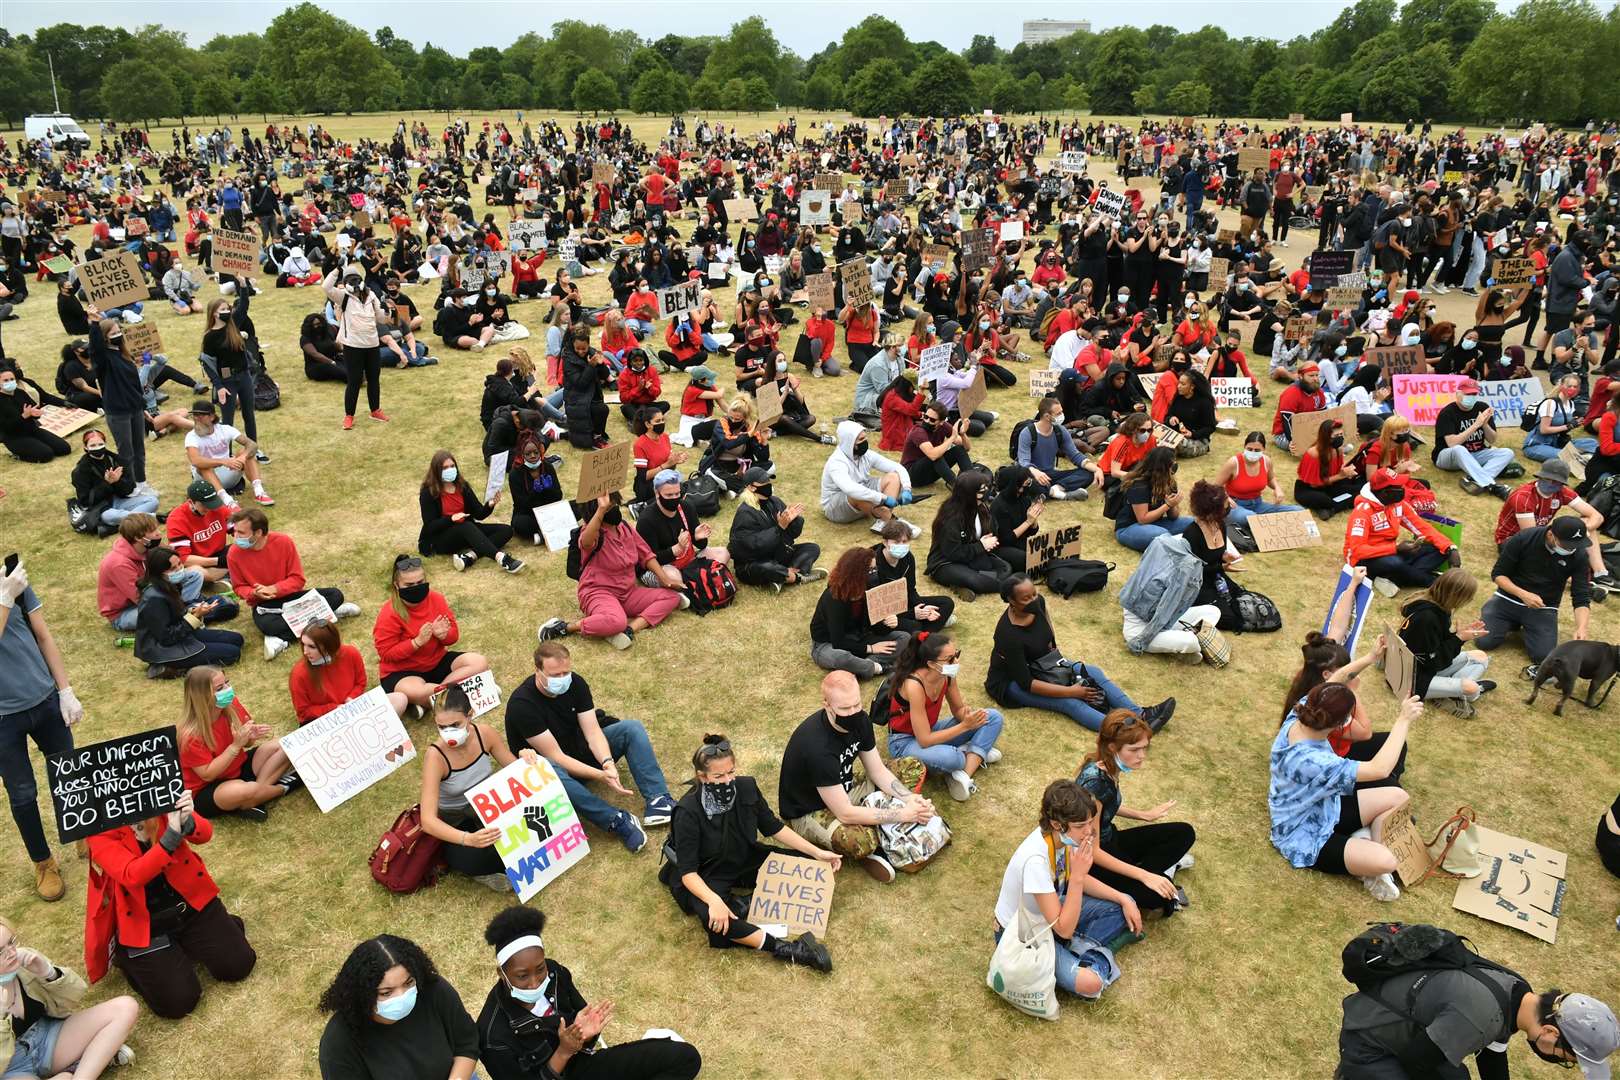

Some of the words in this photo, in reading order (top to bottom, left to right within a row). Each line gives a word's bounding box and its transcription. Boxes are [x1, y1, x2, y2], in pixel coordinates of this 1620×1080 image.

[1100, 189, 1123, 204] ENOUGH
[1095, 201, 1120, 217] ENOUGH
[212, 227, 225, 236] WE
[225, 229, 257, 244] DEMAND
[509, 223, 533, 231] BLACK
[216, 237, 250, 251] JUSTICE
[213, 248, 223, 256] WE
[224, 250, 253, 262] DEMAND
[84, 256, 126, 277] BLACK
[221, 258, 252, 272] CHANGE
[848, 263, 859, 273] IN
[1500, 260, 1521, 270] THE
[1522, 259, 1534, 268] UK
[89, 268, 130, 287] LIVES
[90, 278, 139, 302] MATTER
[848, 283, 874, 298] BLACK
[664, 285, 699, 314] BLM
[1376, 351, 1418, 368] BLACK
[1038, 371, 1053, 379] THE
[1210, 378, 1226, 387] NO
[1213, 386, 1252, 395] JUSTICE
[1396, 379, 1456, 395] JUSTICE
[1478, 382, 1530, 398] BLACK
[1227, 397, 1253, 407] PEACE
[1490, 397, 1524, 409] LIVES
[1492, 408, 1526, 421] ATTE
[592, 447, 623, 469] BLACK
[596, 460, 624, 478] LIVES
[590, 476, 623, 495] MATTER
[1256, 512, 1302, 528] BLACK
[1027, 533, 1049, 555] YOU
[1054, 524, 1081, 548] ARE
[1268, 525, 1306, 538] LIVES
[1040, 544, 1065, 562] NOT
[294, 704, 404, 789] JUSTICE
[50, 751, 94, 777] YOUR
[97, 734, 173, 765] UNIFORM
[53, 776, 91, 796] does
[92, 766, 120, 785] not
[125, 753, 166, 775] MAKE
[60, 790, 88, 811] YOU
[94, 759, 181, 798] INNOCENT!
[472, 760, 557, 824] BLACK
[62, 808, 98, 831] DO
[105, 778, 183, 819] BETTER
[495, 793, 573, 857] LIVES
[504, 822, 590, 895] MATTER
[766, 859, 826, 883] BLACK
[762, 879, 825, 904] LIVES
[752, 896, 825, 926] MATTER
[1007, 990, 1046, 1000] BUNDES
